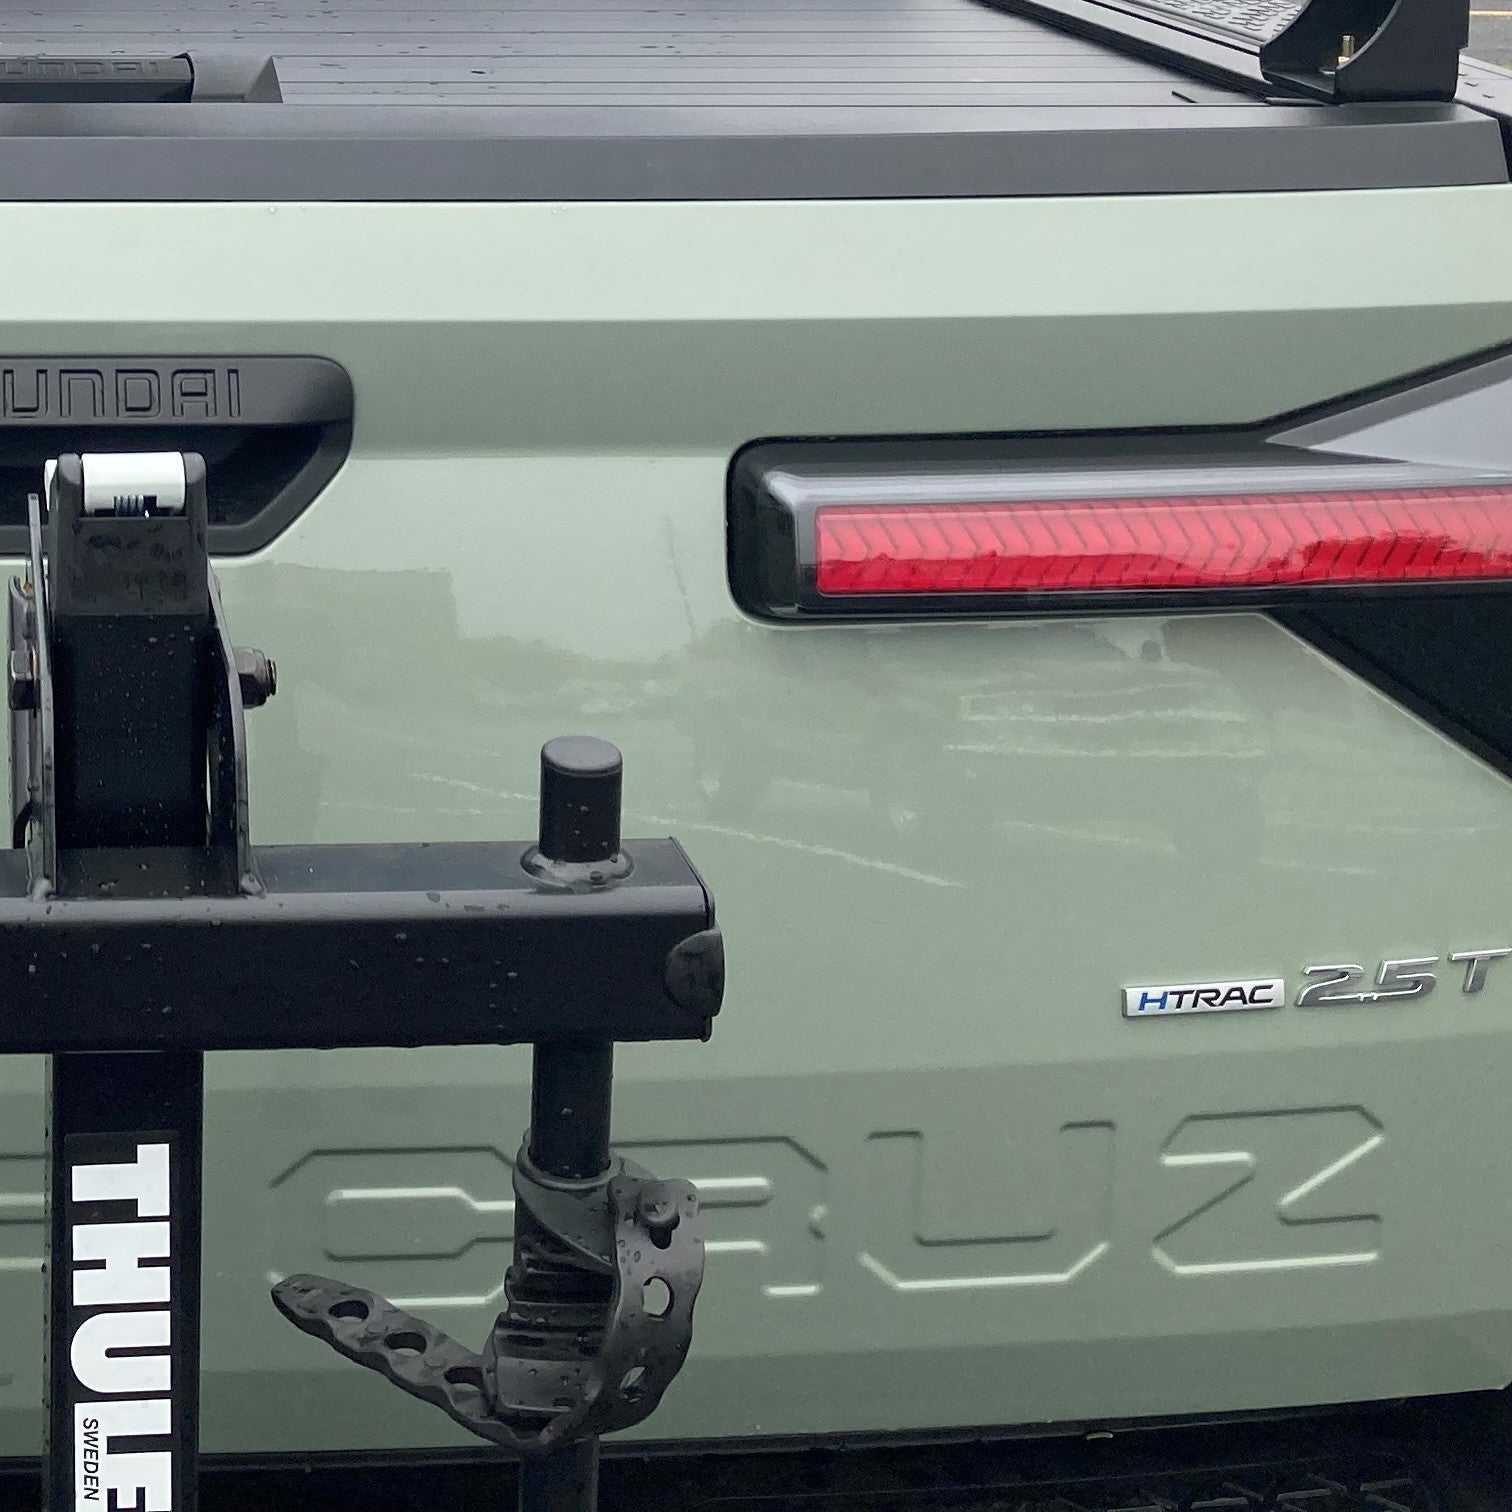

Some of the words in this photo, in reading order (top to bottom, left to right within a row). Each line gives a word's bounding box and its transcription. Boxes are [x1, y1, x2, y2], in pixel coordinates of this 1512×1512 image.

[1138, 983, 1275, 1011] HTRAC
[70, 1143, 173, 1512] THULE
[83, 1417, 100, 1502] SWEDEN
